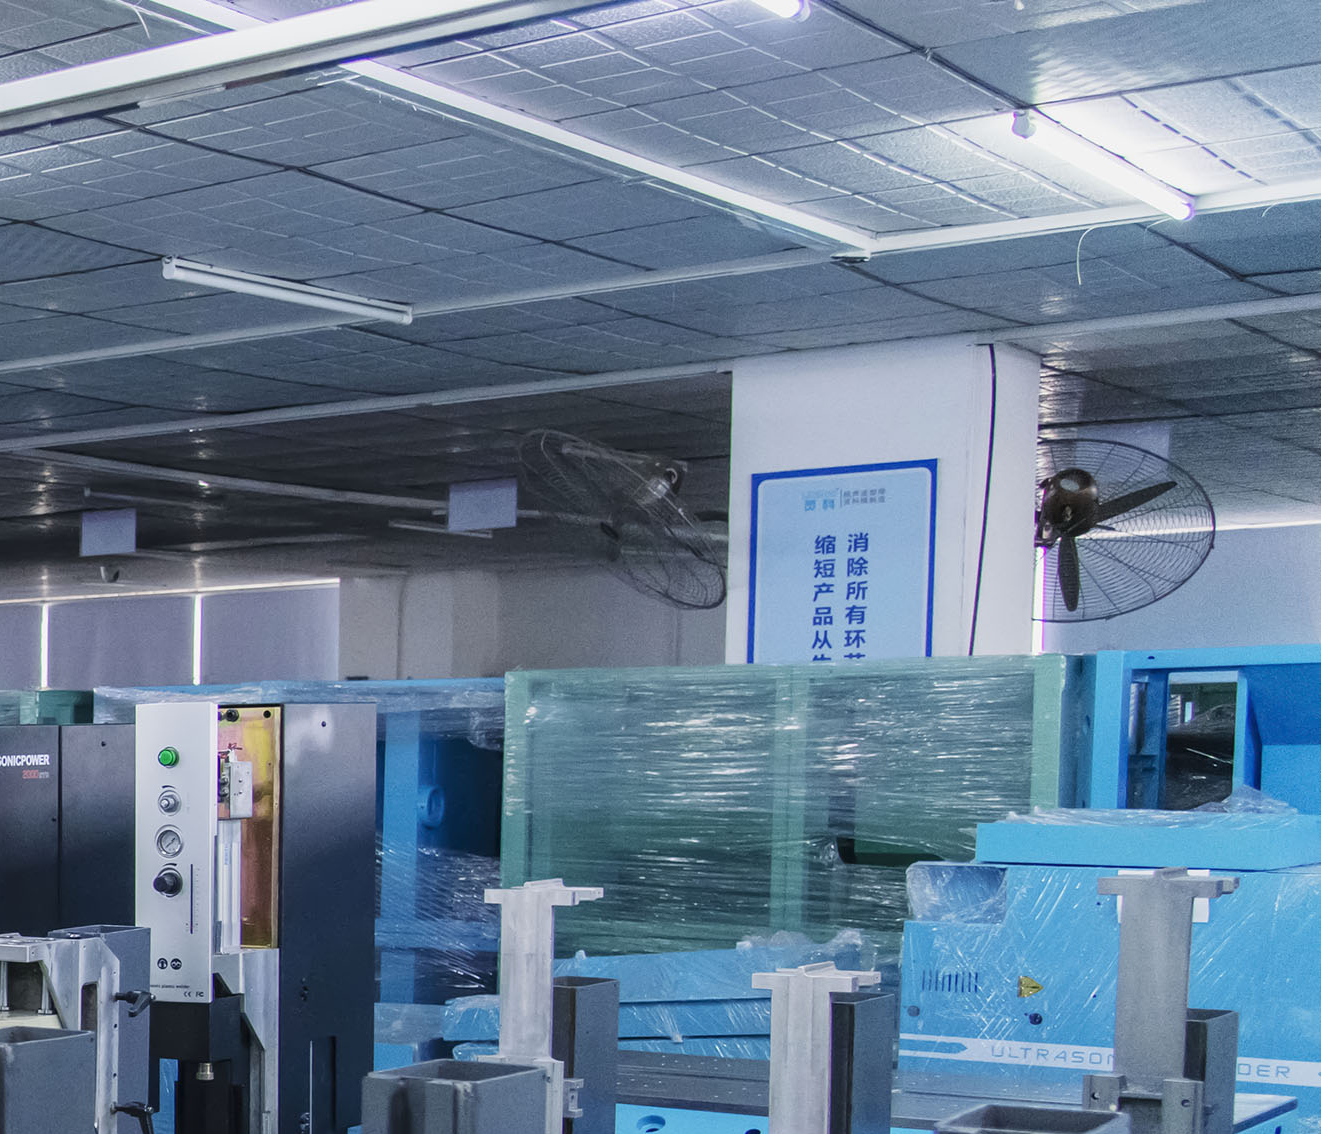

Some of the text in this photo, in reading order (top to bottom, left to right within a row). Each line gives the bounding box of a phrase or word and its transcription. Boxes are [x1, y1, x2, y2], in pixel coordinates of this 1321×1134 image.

[843, 532, 869, 659] 消除所有环
[1237, 1063, 1291, 1079] DER
